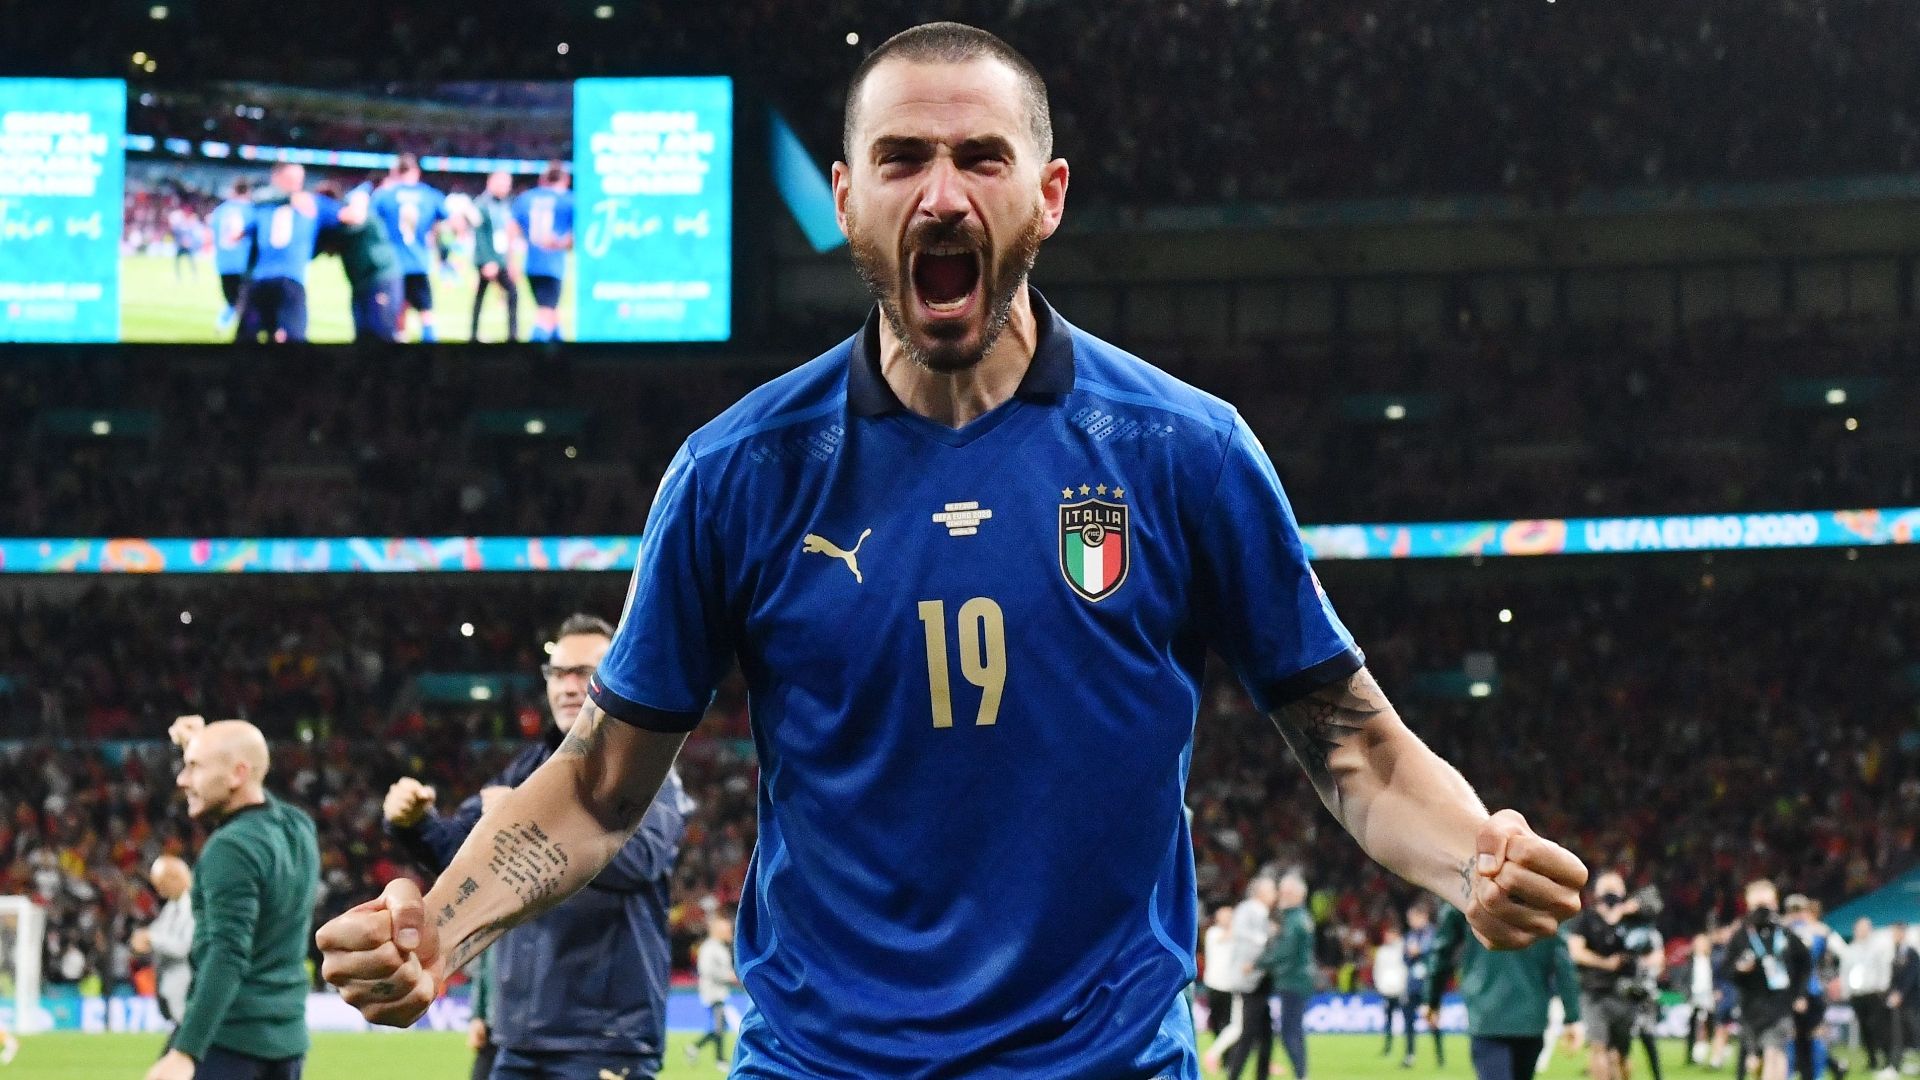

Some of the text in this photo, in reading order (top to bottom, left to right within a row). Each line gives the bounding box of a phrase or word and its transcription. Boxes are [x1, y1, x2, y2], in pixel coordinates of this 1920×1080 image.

[1065, 509, 1121, 525] ITALIA
[1585, 513, 1818, 550] UEFA EURO 2020
[918, 596, 1007, 728] 19
